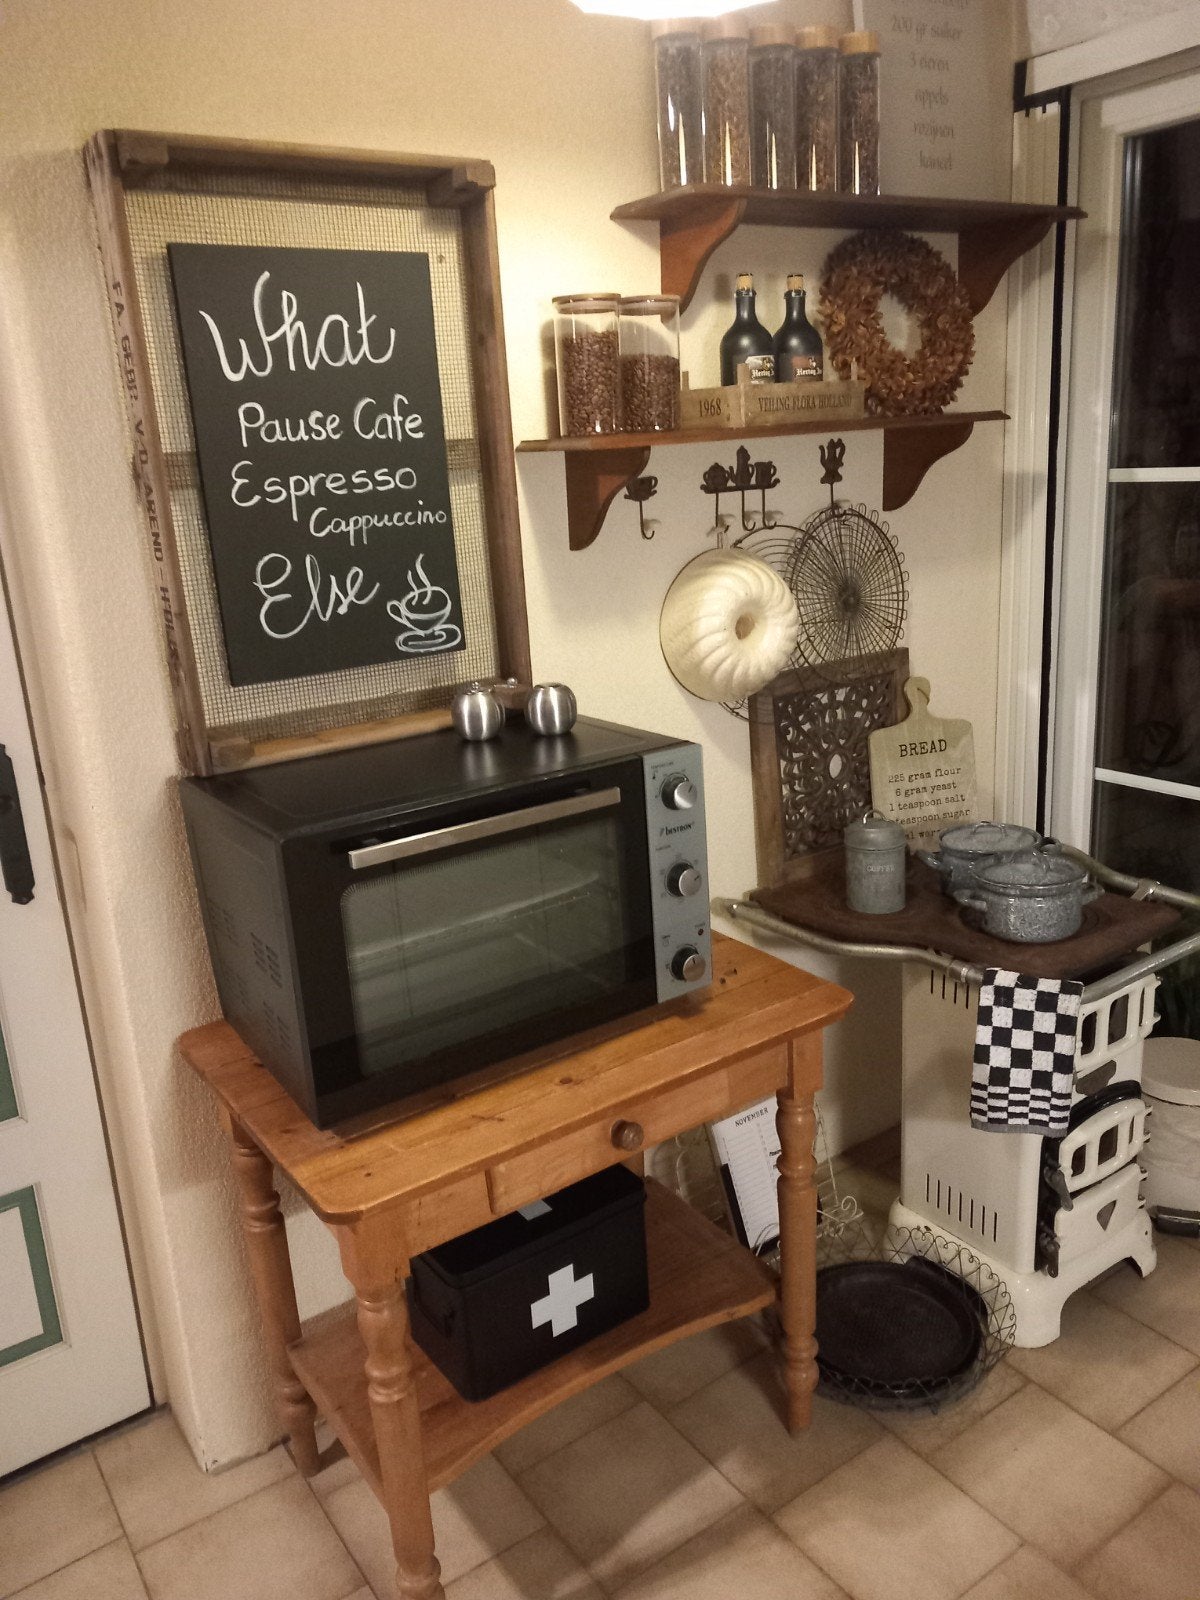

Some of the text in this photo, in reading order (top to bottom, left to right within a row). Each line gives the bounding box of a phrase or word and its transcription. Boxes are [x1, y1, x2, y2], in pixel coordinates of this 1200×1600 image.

[199, 270, 397, 383] What
[699, 397, 722, 418] 1968
[758, 396, 791, 413] VEILING
[792, 394, 816, 410] FLORA
[237, 393, 425, 448] Pause Cafe
[230, 460, 418, 522] Espresso
[143, 481, 163, 561] AREND
[309, 500, 448, 546] Cappuccino
[252, 552, 381, 639] Else
[898, 739, 947, 757] BREAD
[888, 767, 961, 784] 225 gram flour
[895, 781, 957, 798] 6 gram yeast
[898, 798, 942, 811] teaspoon
[944, 794, 966, 804] salt
[942, 809, 971, 820] sugar
[735, 1107, 768, 1127] NOVEMBER
